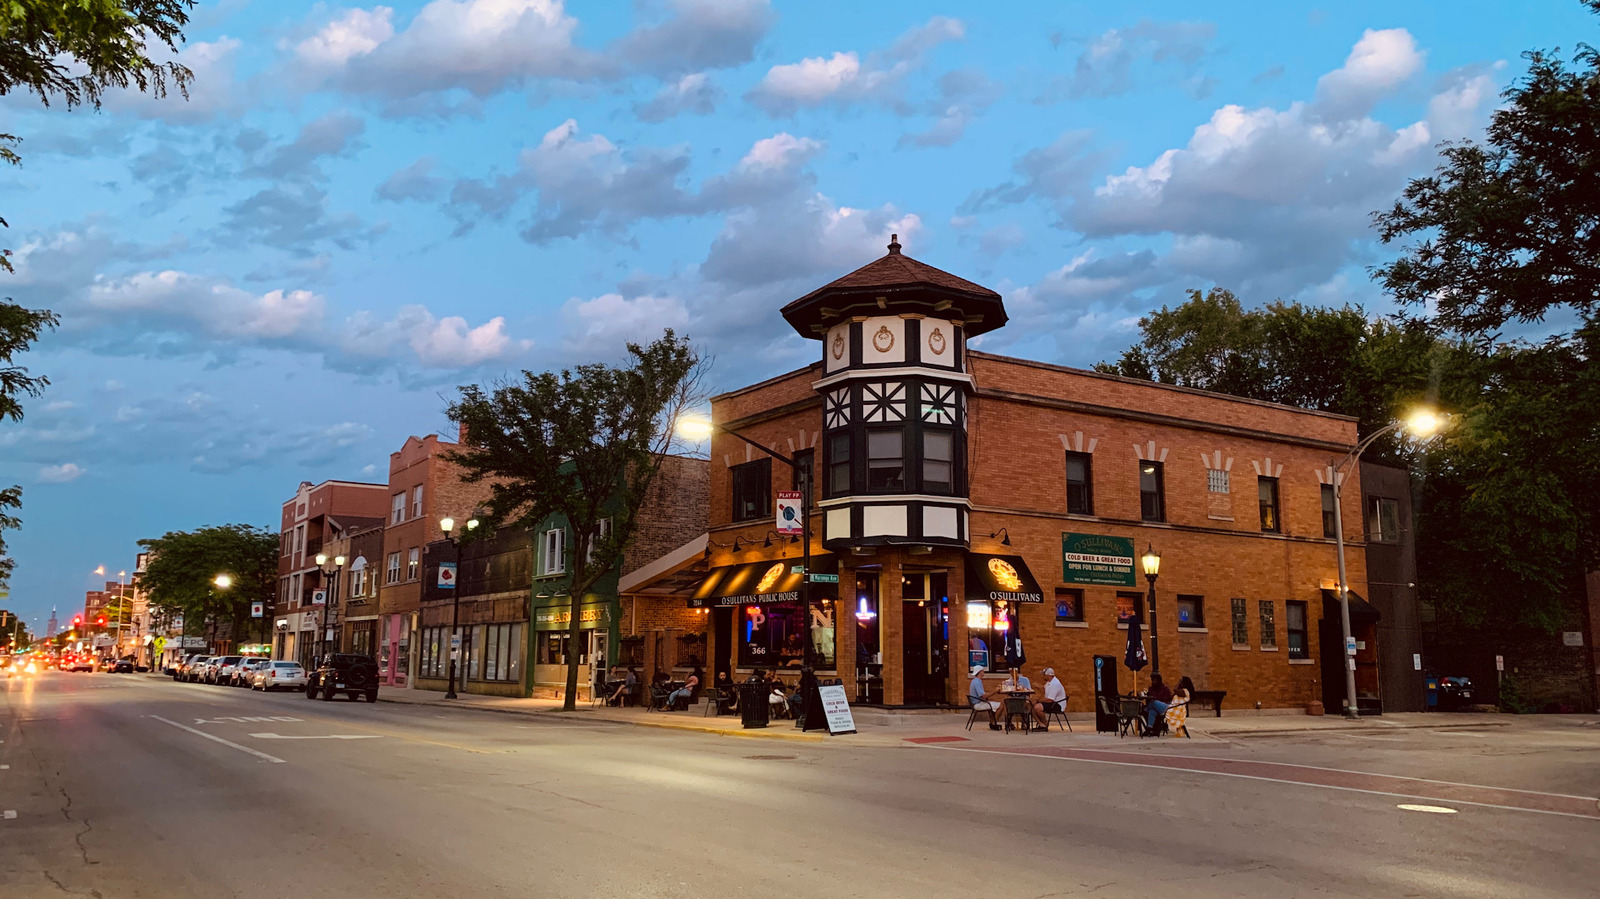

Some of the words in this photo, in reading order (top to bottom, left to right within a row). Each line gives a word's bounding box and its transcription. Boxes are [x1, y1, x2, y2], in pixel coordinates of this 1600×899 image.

[758, 593, 778, 603] PUBLIC
[778, 591, 798, 601] HOUSE
[990, 591, 1041, 602] O'SULLIVANS
[751, 647, 766, 655] 366
